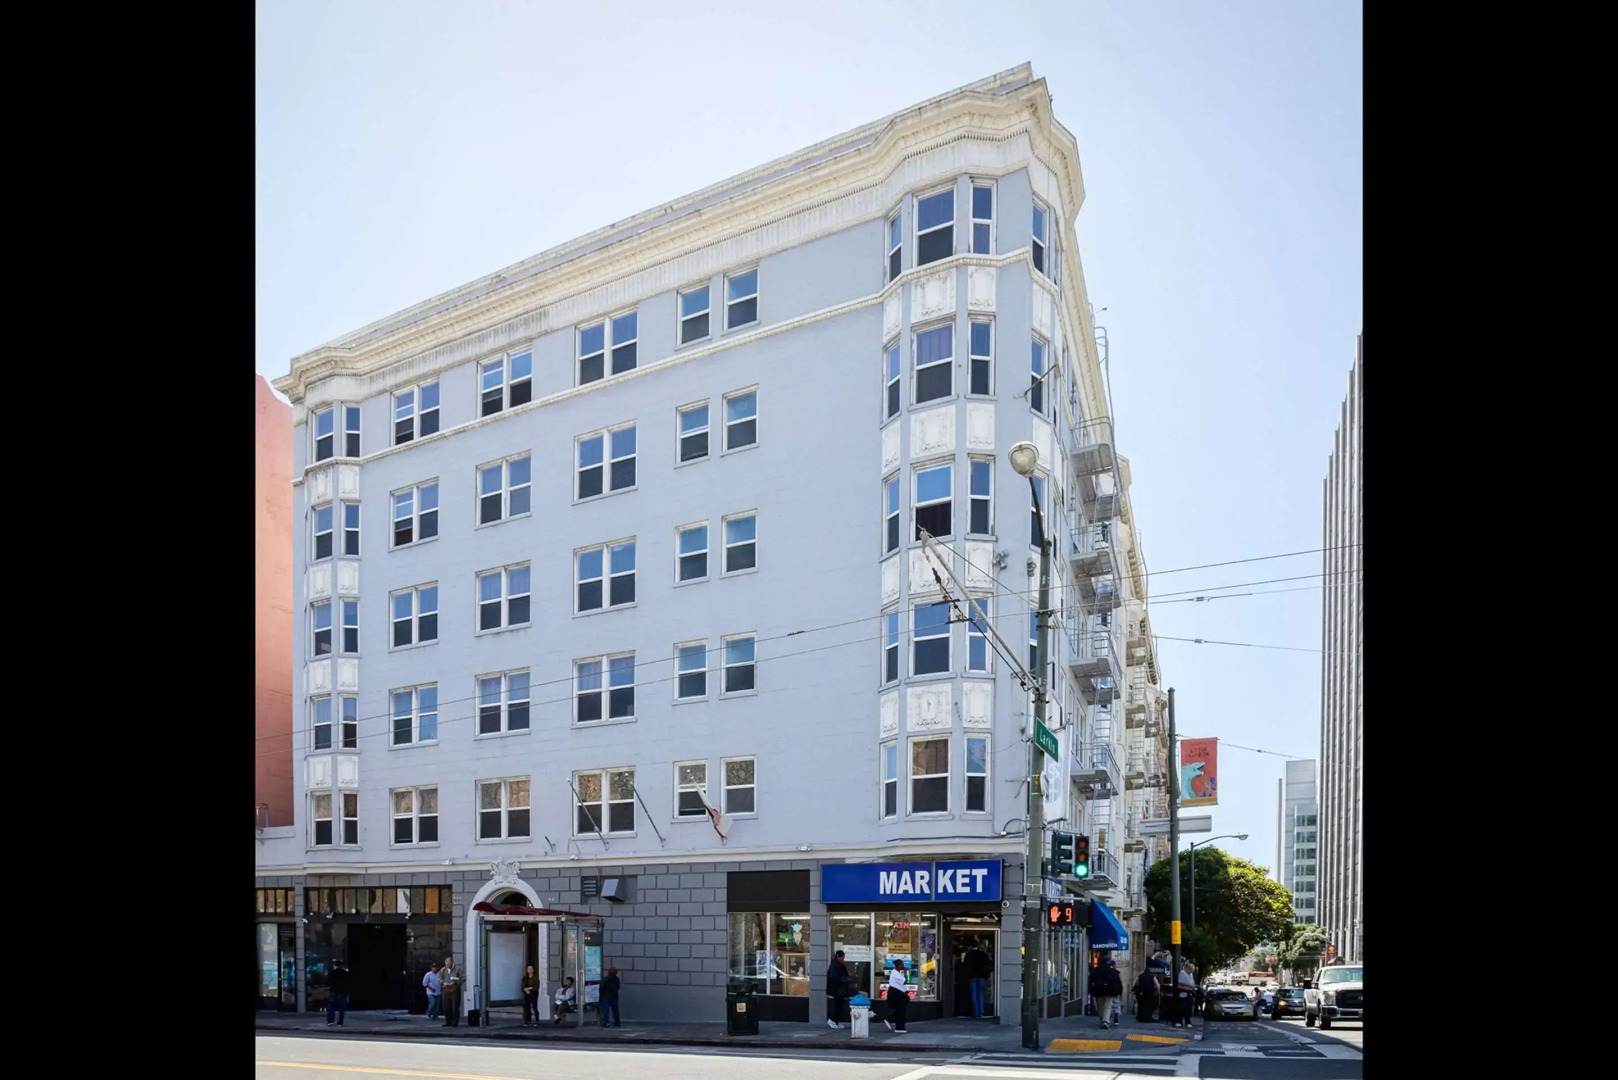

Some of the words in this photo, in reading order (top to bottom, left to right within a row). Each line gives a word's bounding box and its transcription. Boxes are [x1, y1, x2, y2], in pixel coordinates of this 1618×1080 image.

[1039, 728, 1055, 754] Larkin
[879, 868, 988, 895] MARKET
[1065, 907, 1072, 922] 9
[892, 921, 910, 929] ATM
